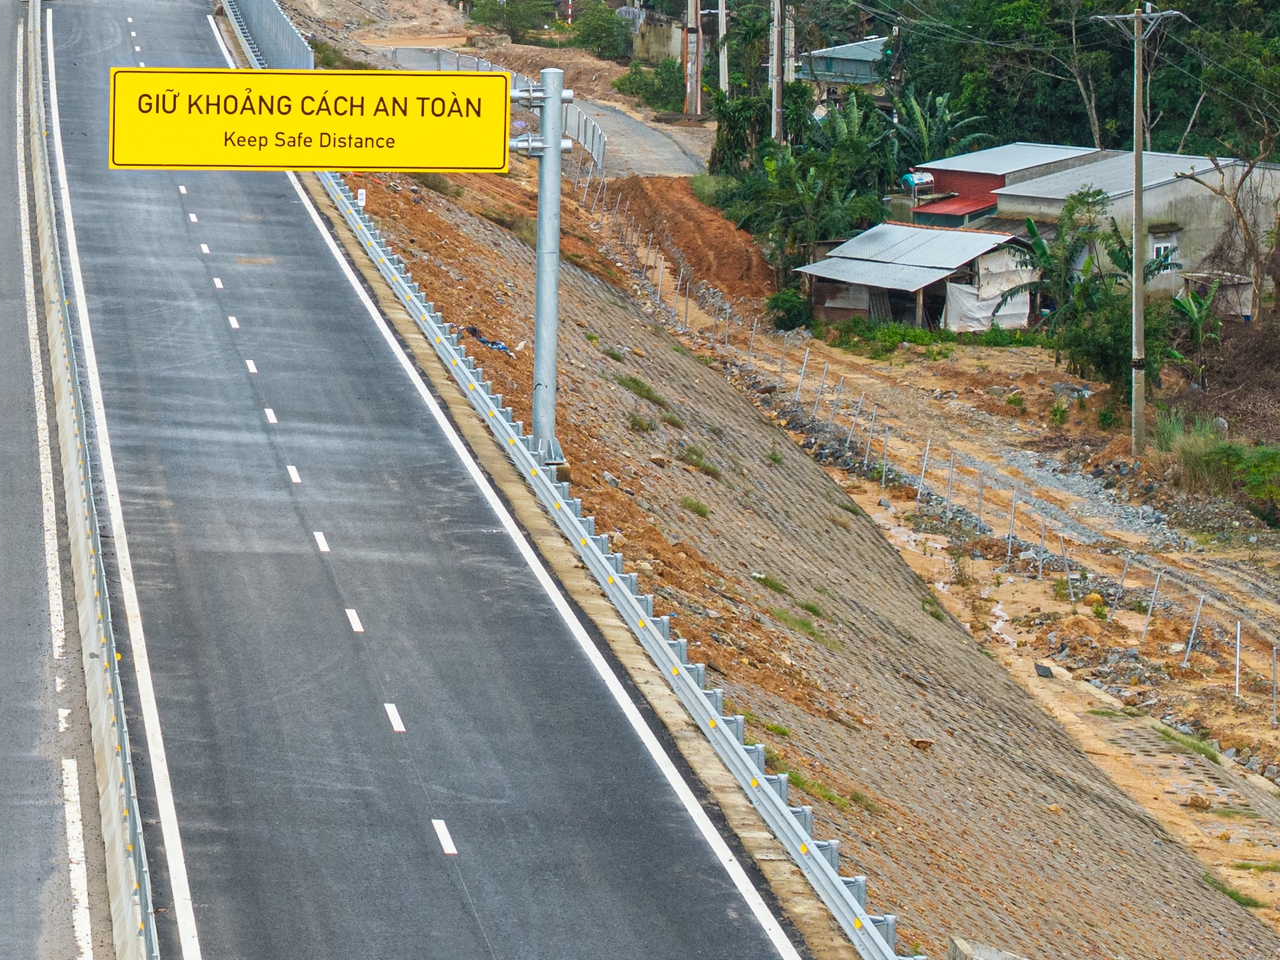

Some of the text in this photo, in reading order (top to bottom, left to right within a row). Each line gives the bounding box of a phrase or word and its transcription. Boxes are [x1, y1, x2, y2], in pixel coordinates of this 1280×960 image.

[137, 87, 482, 118] GIỮ KHOẢNG CÁCH AN TOÀN
[224, 131, 396, 151] Keep Safe Distance
